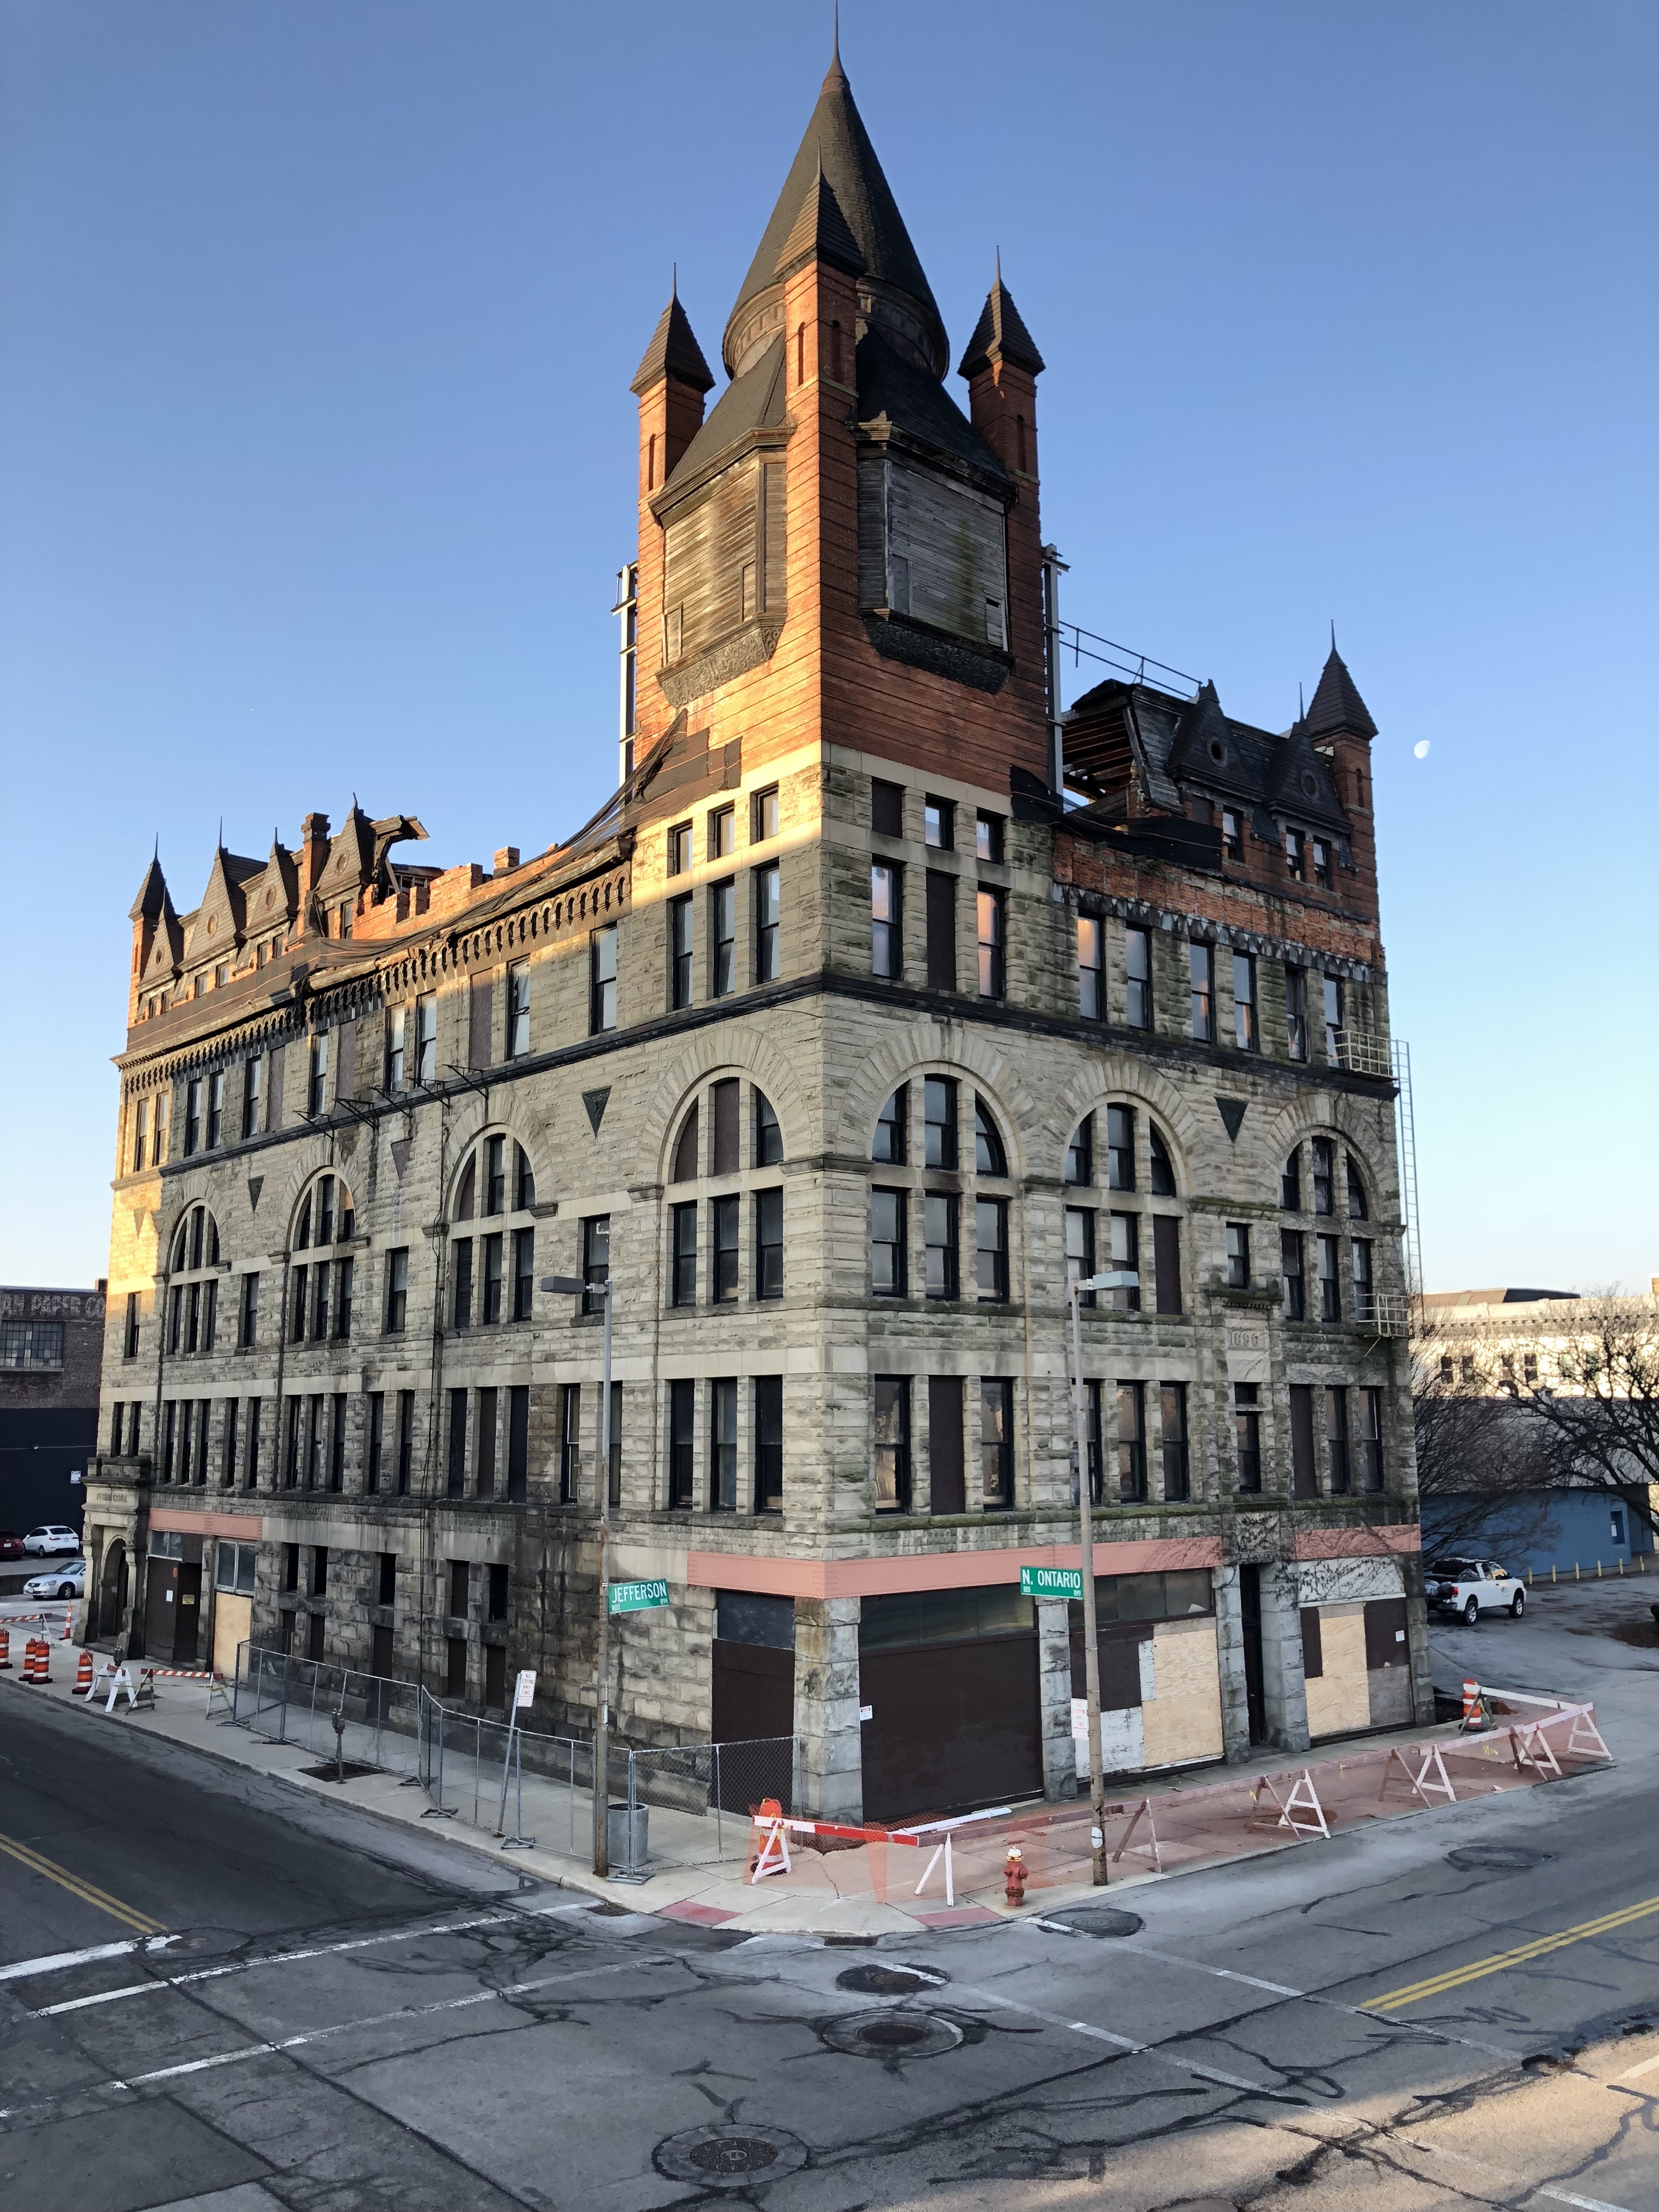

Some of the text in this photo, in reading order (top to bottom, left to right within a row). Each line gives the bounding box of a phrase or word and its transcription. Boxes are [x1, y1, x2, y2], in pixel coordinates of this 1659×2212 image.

[1229, 1331, 1260, 1347] 1890
[1022, 1569, 1081, 1589] N. ONTARIO
[612, 1582, 667, 1604] JEFFERSON
